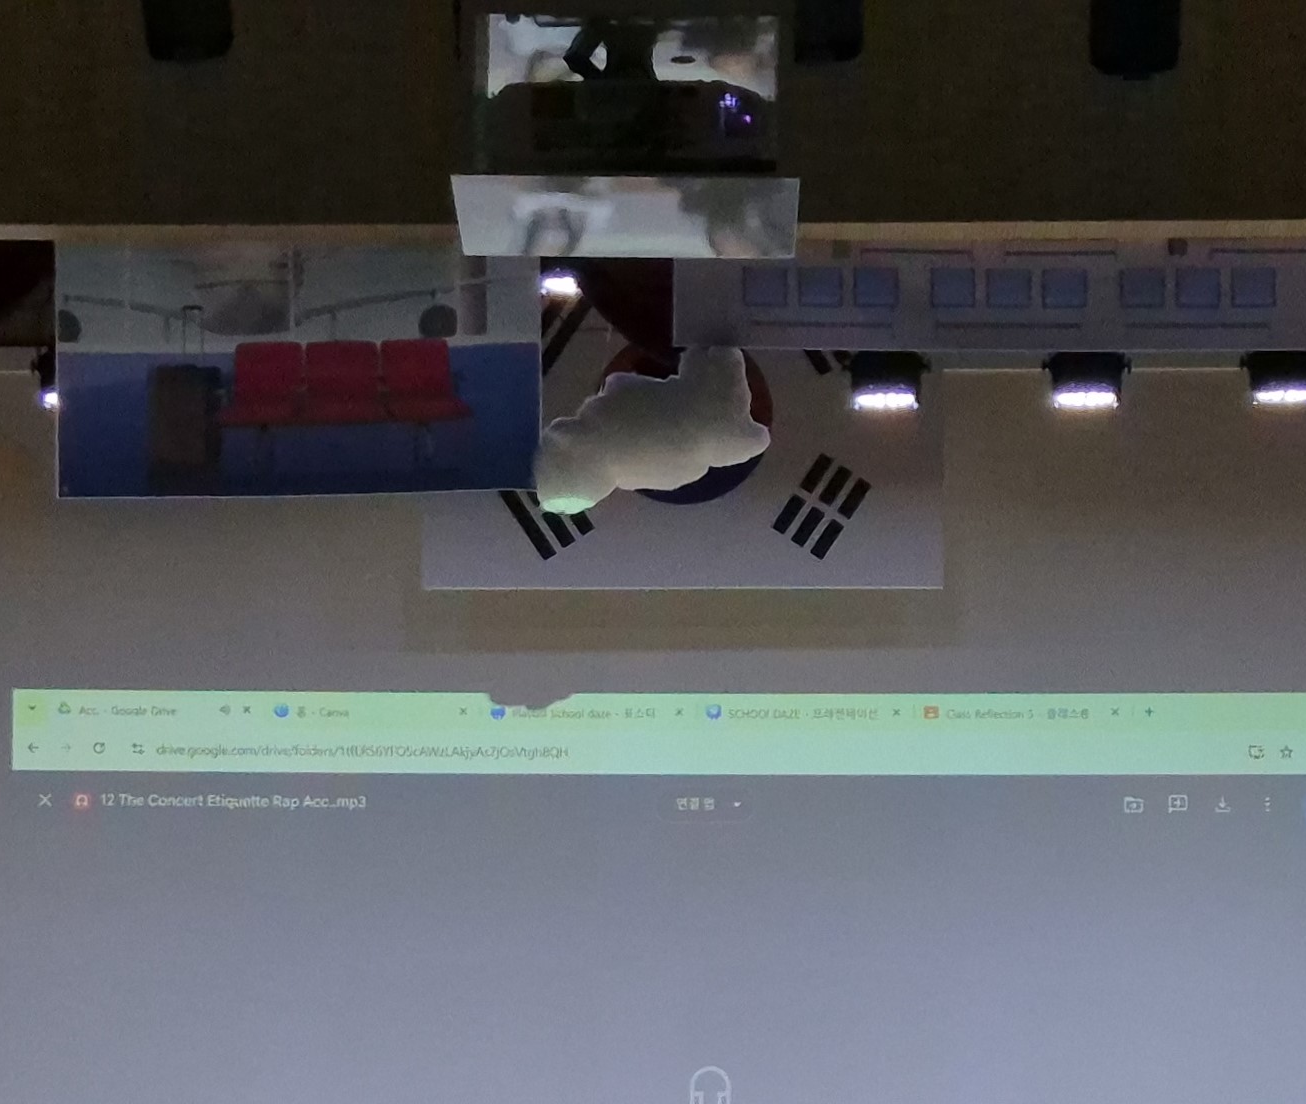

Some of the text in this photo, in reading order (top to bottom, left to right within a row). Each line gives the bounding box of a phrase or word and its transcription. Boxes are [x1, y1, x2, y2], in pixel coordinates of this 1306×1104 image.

[111, 705, 147, 717] Google
[151, 705, 177, 716] Drive
[101, 793, 114, 806] 12
[119, 793, 144, 806] The
[148, 794, 204, 807] Concert
[207, 794, 270, 809] Etiquette
[273, 794, 300, 810] Rap
